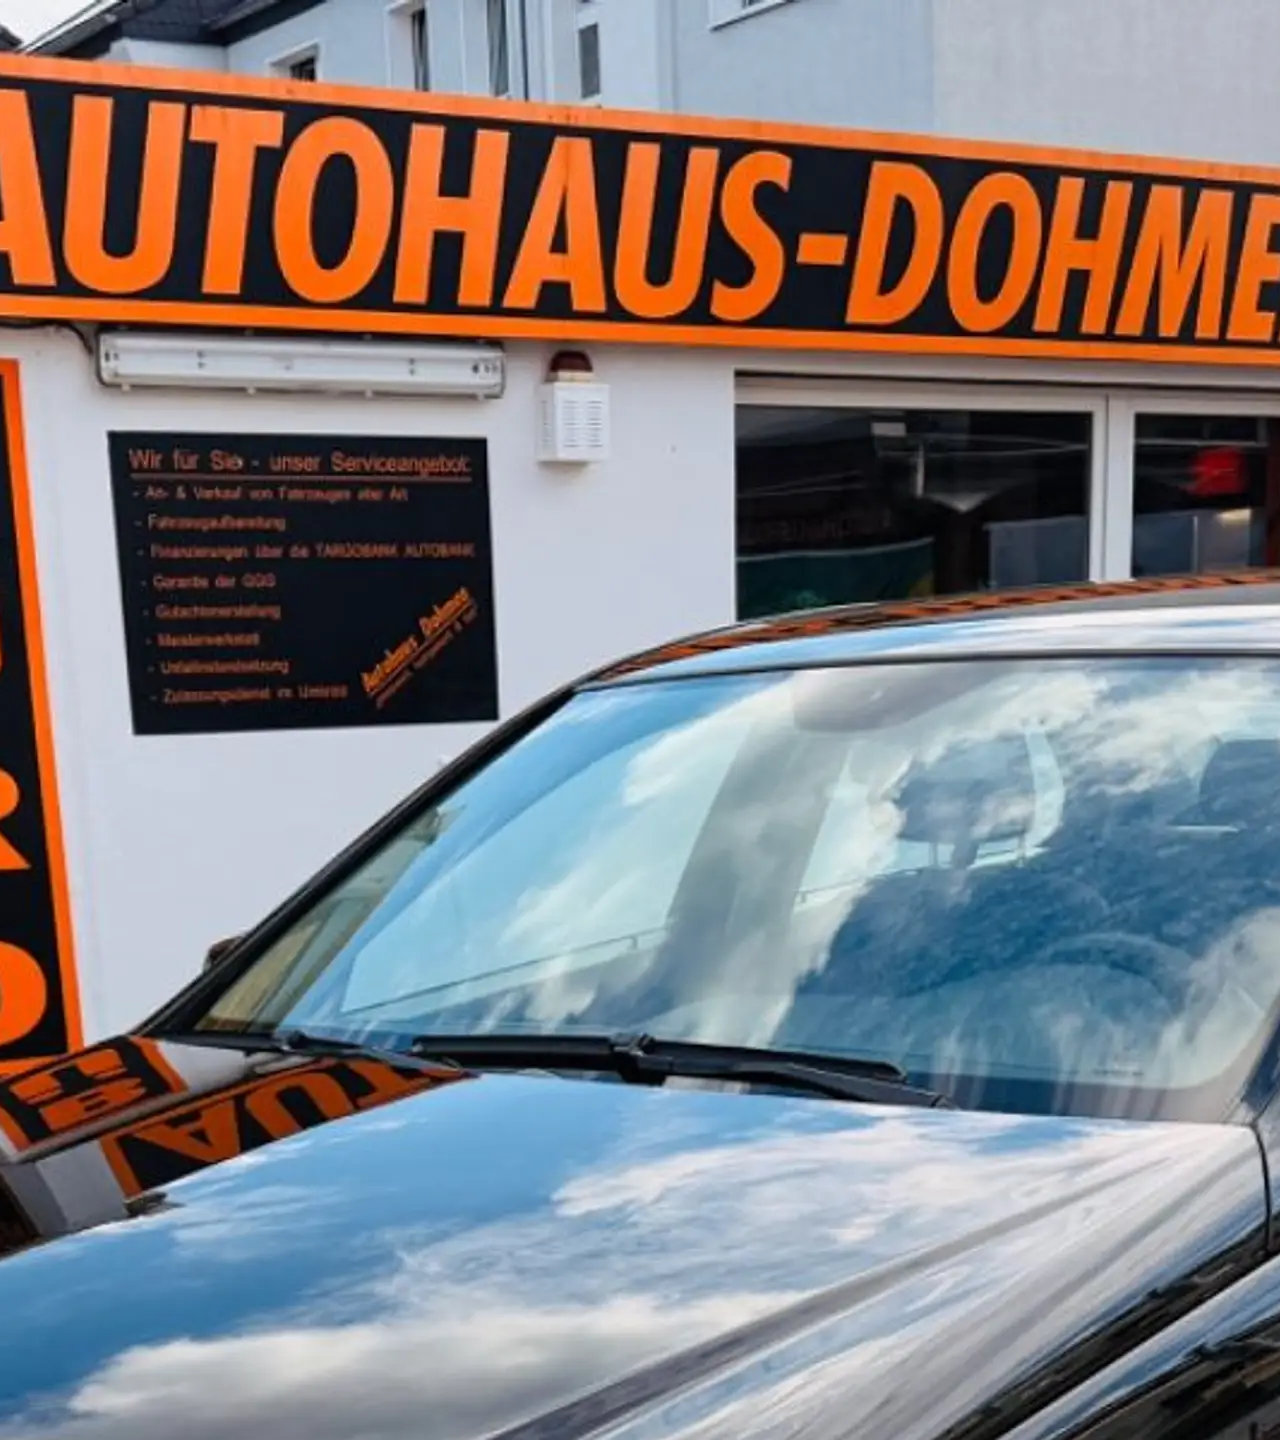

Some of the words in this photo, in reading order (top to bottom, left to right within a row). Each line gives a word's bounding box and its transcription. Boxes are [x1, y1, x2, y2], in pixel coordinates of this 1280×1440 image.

[129, 446, 164, 471] Wir
[172, 447, 201, 471] für
[210, 449, 243, 472] Sie
[269, 454, 322, 472] unser
[248, 488, 273, 502] von
[279, 485, 352, 505] Fahrzeugen
[315, 541, 398, 560] TARGOBANK
